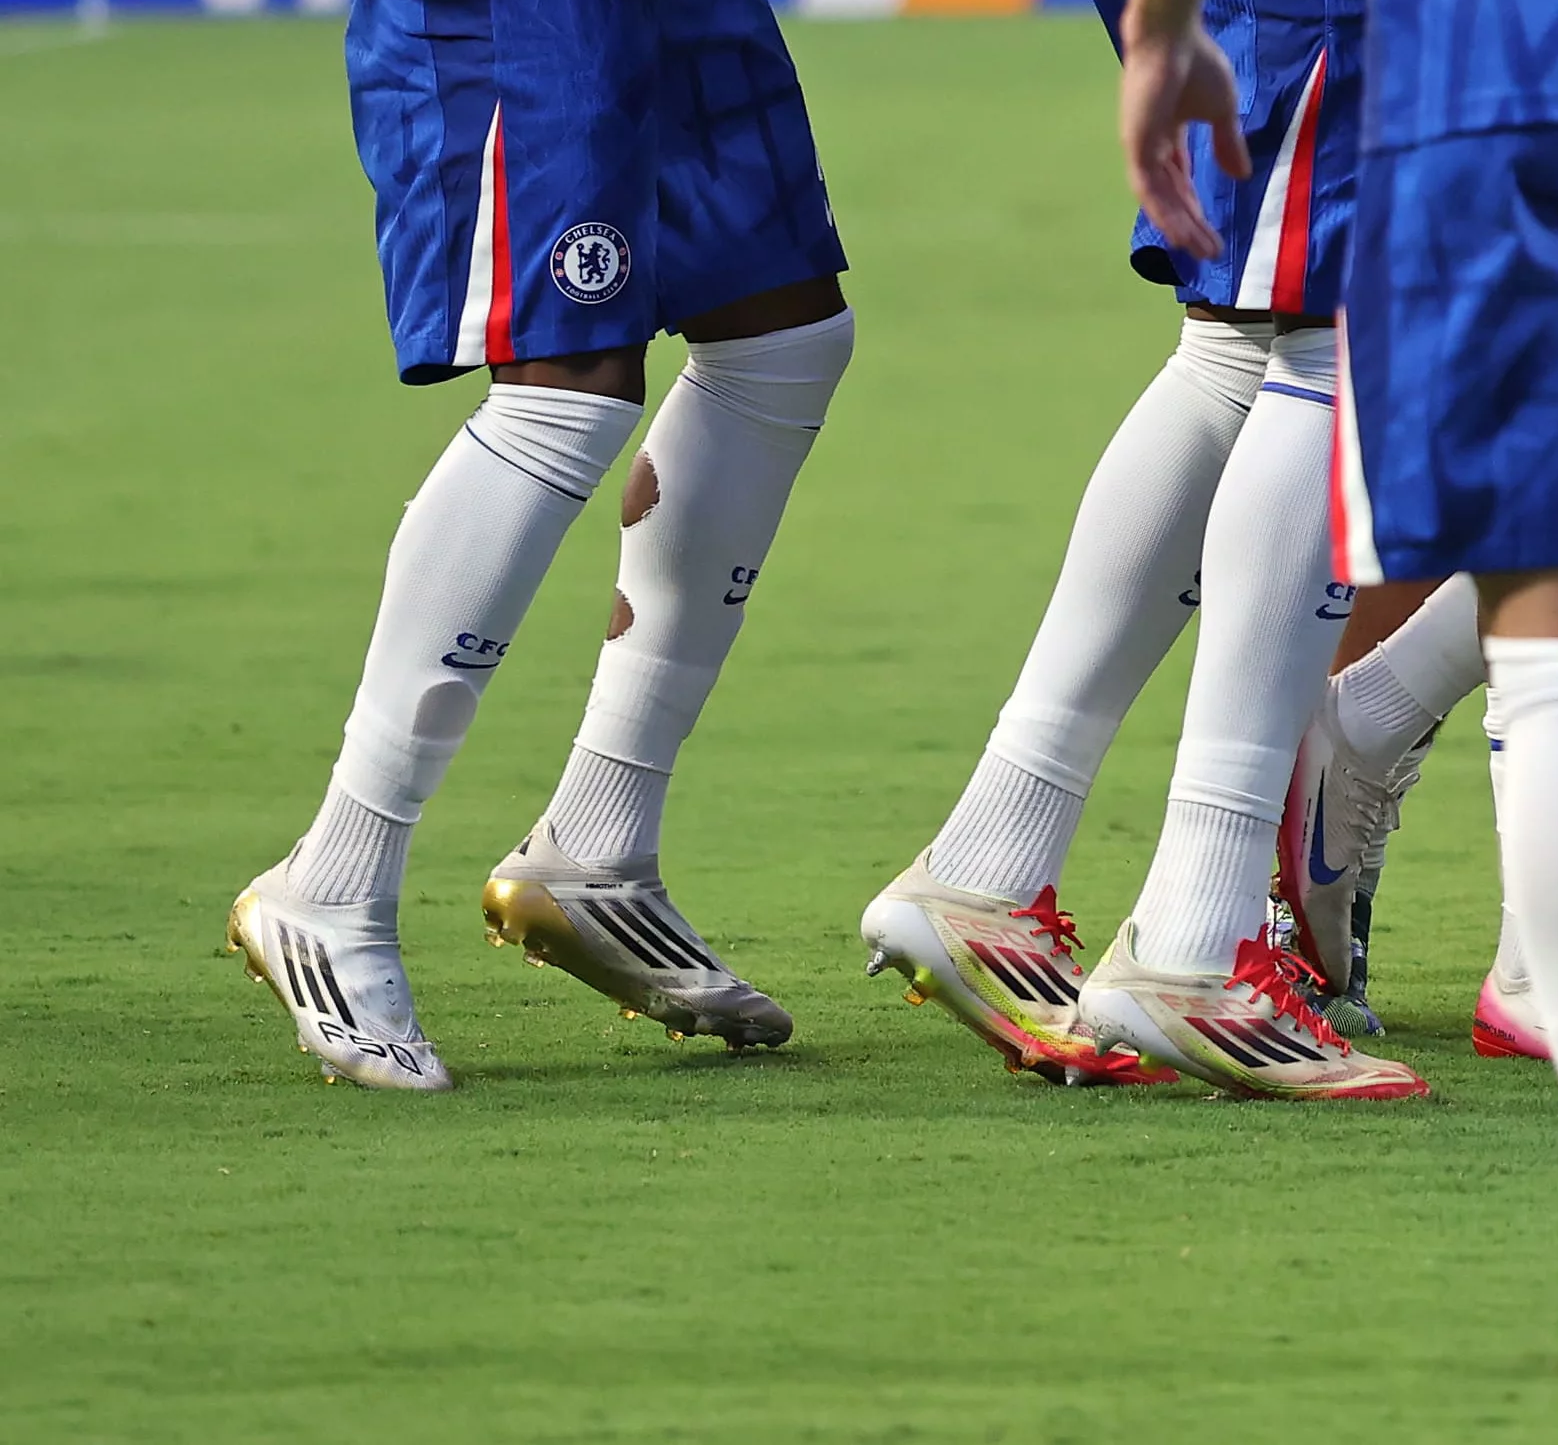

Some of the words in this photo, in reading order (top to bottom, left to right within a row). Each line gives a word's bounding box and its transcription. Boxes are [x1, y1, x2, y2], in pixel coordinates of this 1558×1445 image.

[564, 225, 616, 244] CHELSEA
[731, 566, 759, 586] CF
[1325, 581, 1357, 602] CF
[317, 1020, 423, 1077] F50
